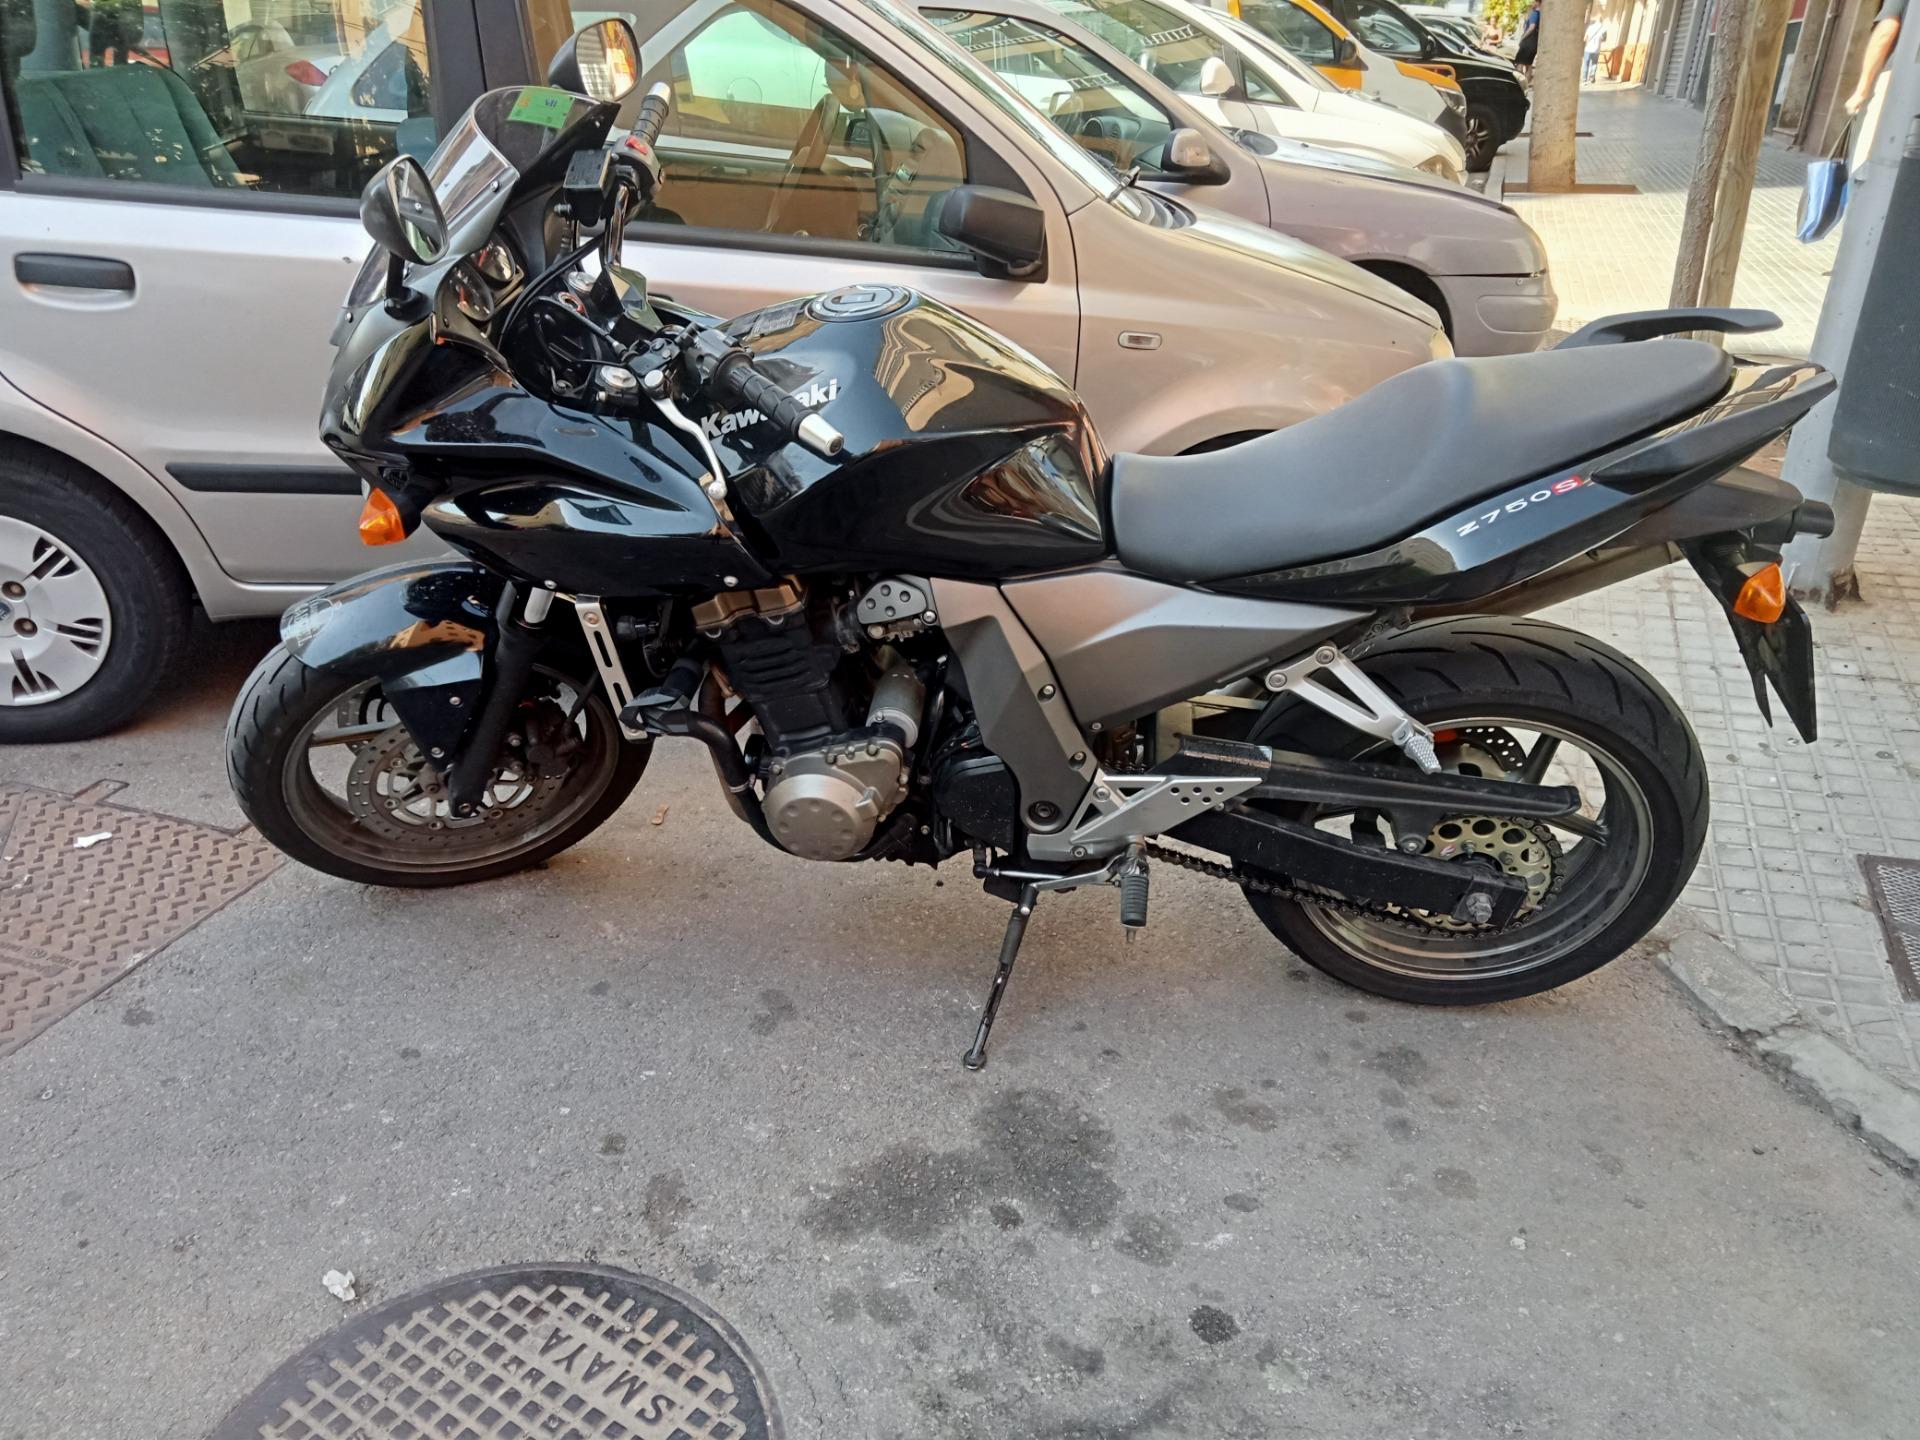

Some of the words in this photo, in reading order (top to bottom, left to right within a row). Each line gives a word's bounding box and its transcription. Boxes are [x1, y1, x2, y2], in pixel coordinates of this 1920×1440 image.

[701, 378, 838, 440] Kawaki
[1456, 478, 1580, 537] Z750S
[538, 1327, 676, 1426] SMAYA
